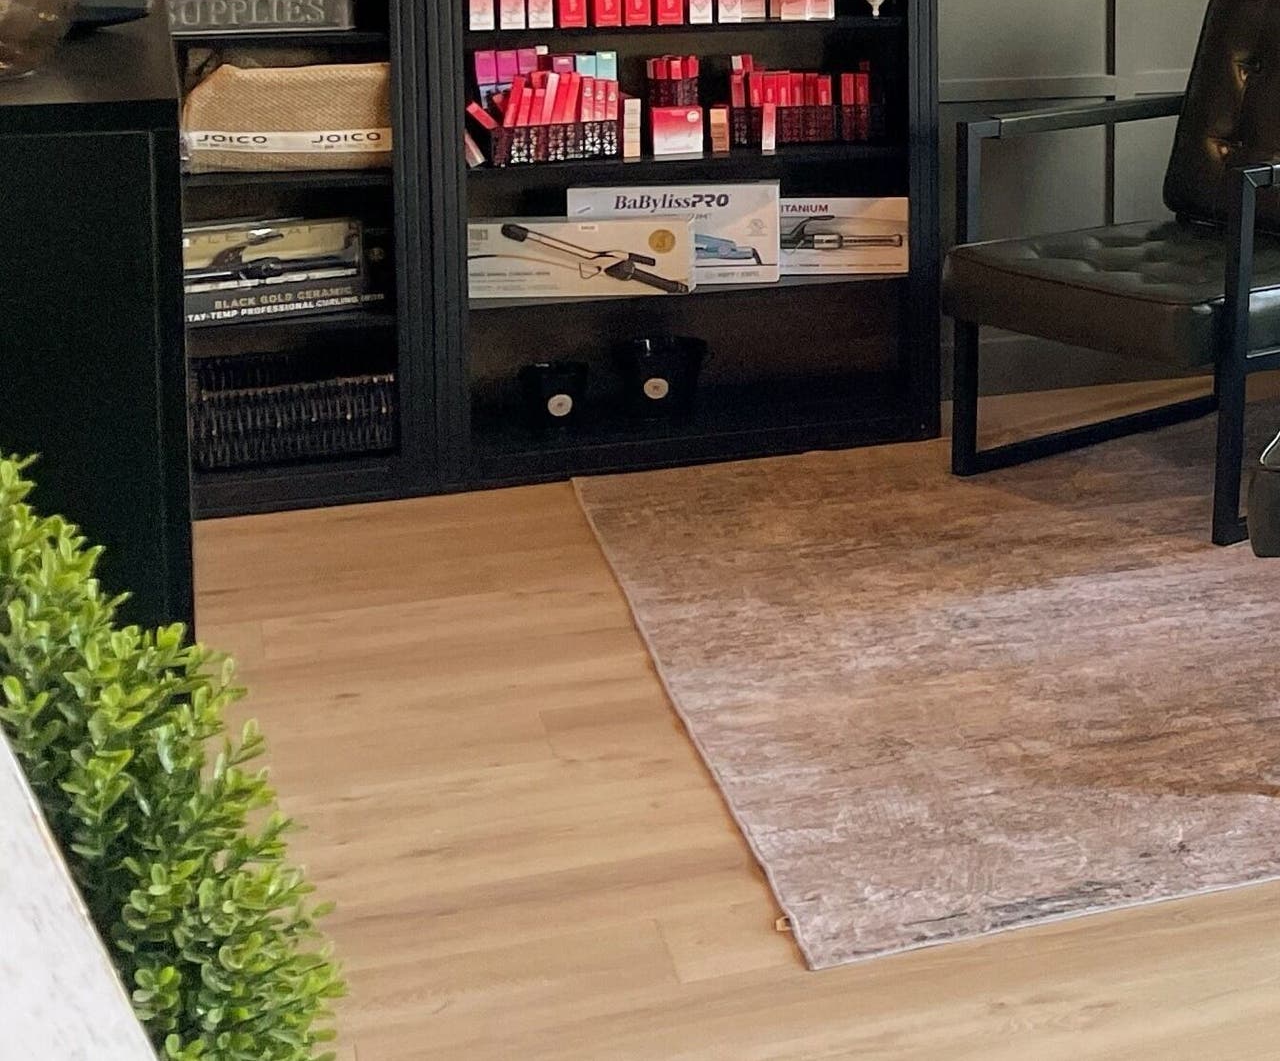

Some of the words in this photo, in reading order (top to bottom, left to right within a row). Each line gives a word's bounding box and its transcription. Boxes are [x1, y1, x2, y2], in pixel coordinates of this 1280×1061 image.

[198, 134, 268, 144] JOICO
[311, 132, 381, 144] JOICO
[780, 204, 829, 214] ITANIUM
[214, 297, 255, 309] BLACK
[260, 292, 293, 304] GOLD
[296, 286, 352, 300] CERAMIC
[187, 309, 239, 322] TAY-TEMP
[240, 300, 315, 317] PROFESSIONAL
